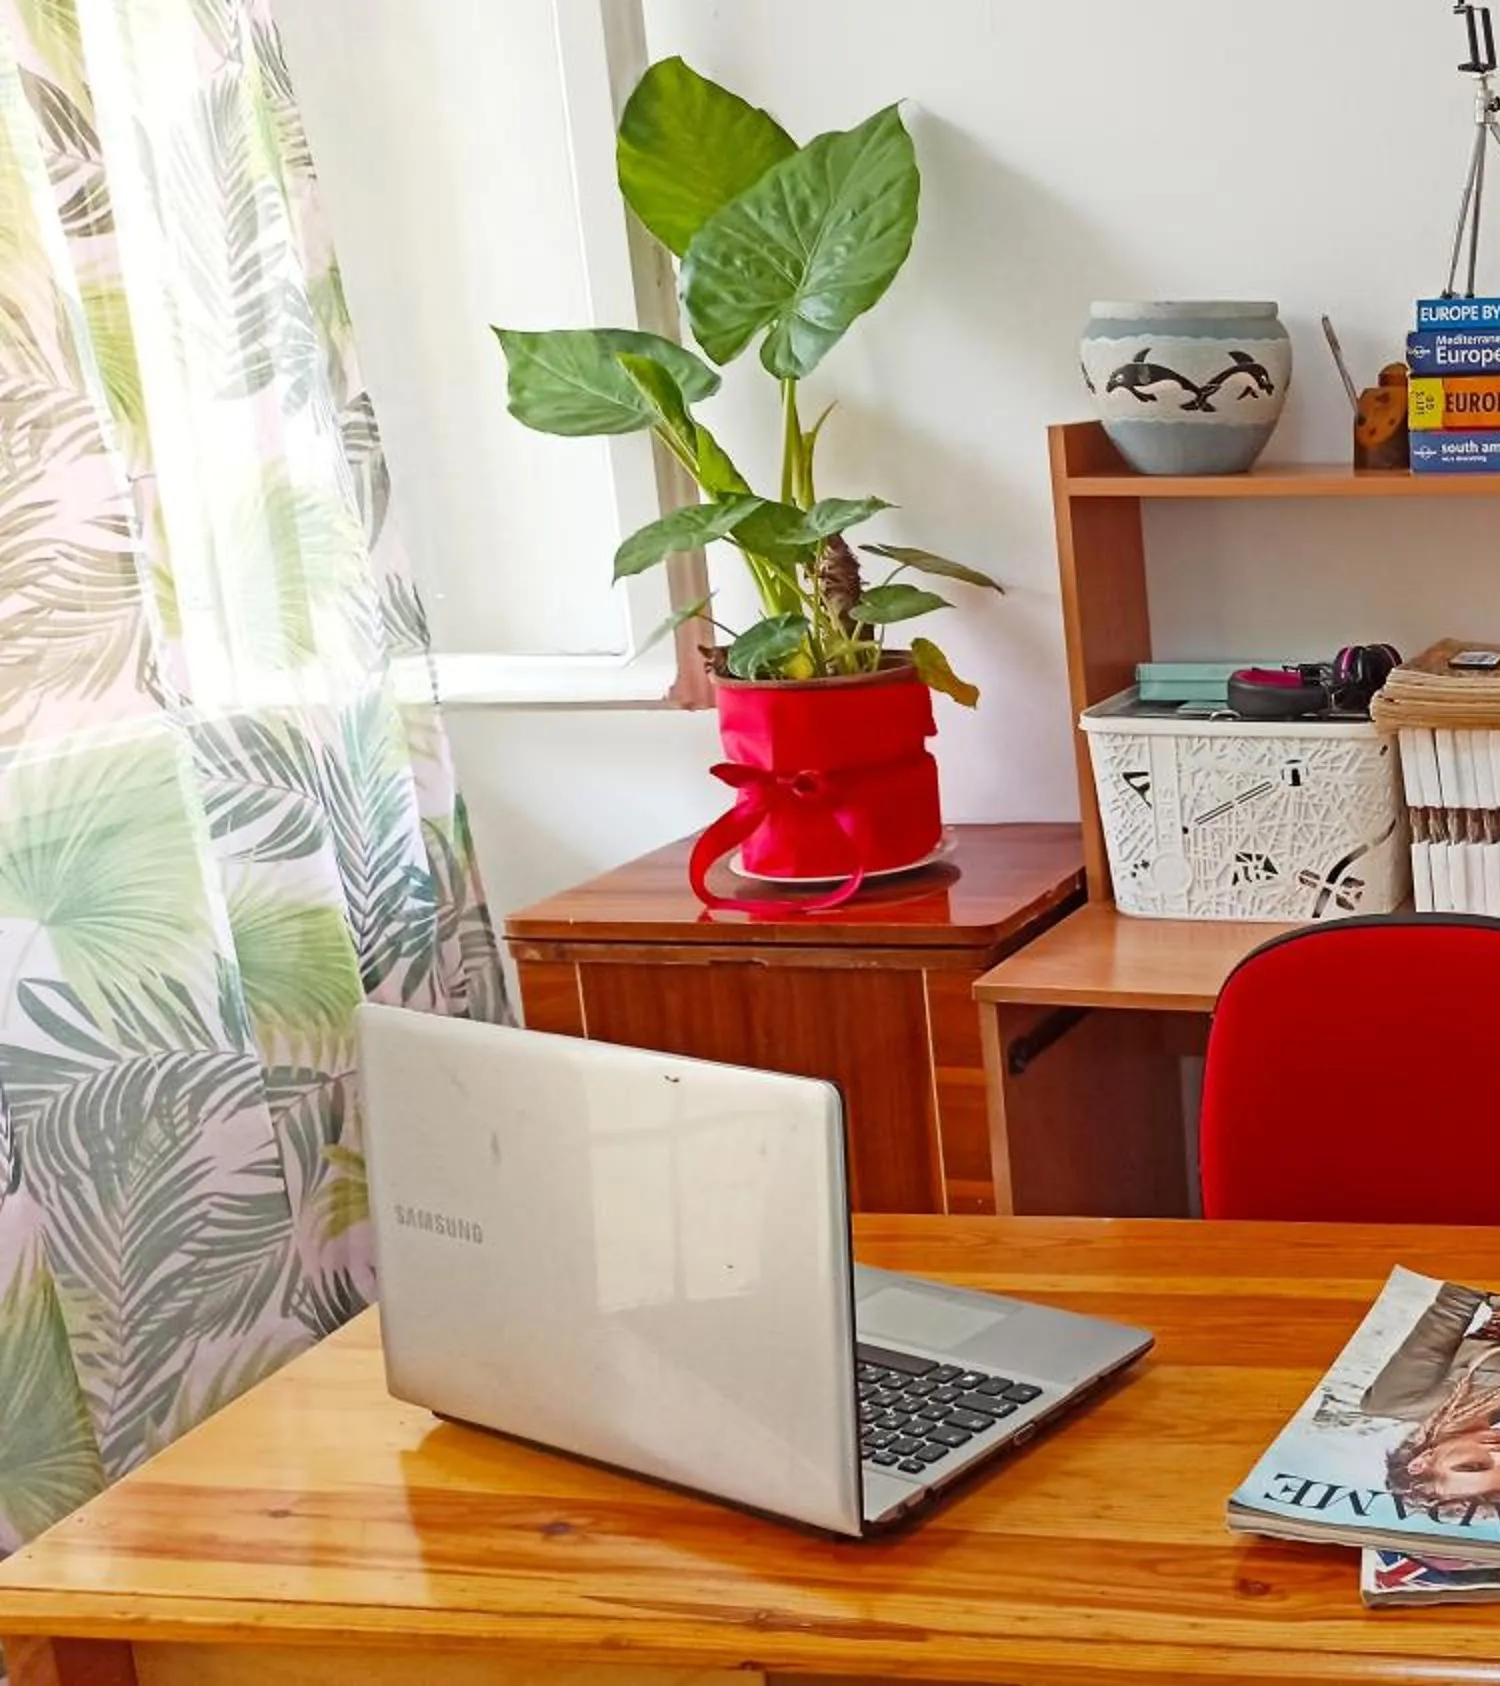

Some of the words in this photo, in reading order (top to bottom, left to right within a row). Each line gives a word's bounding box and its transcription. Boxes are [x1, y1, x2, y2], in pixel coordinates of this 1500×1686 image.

[1420, 306, 1479, 321] EUROPE
[1441, 440, 1479, 453] south
[393, 1204, 483, 1244] SAMSUNG
